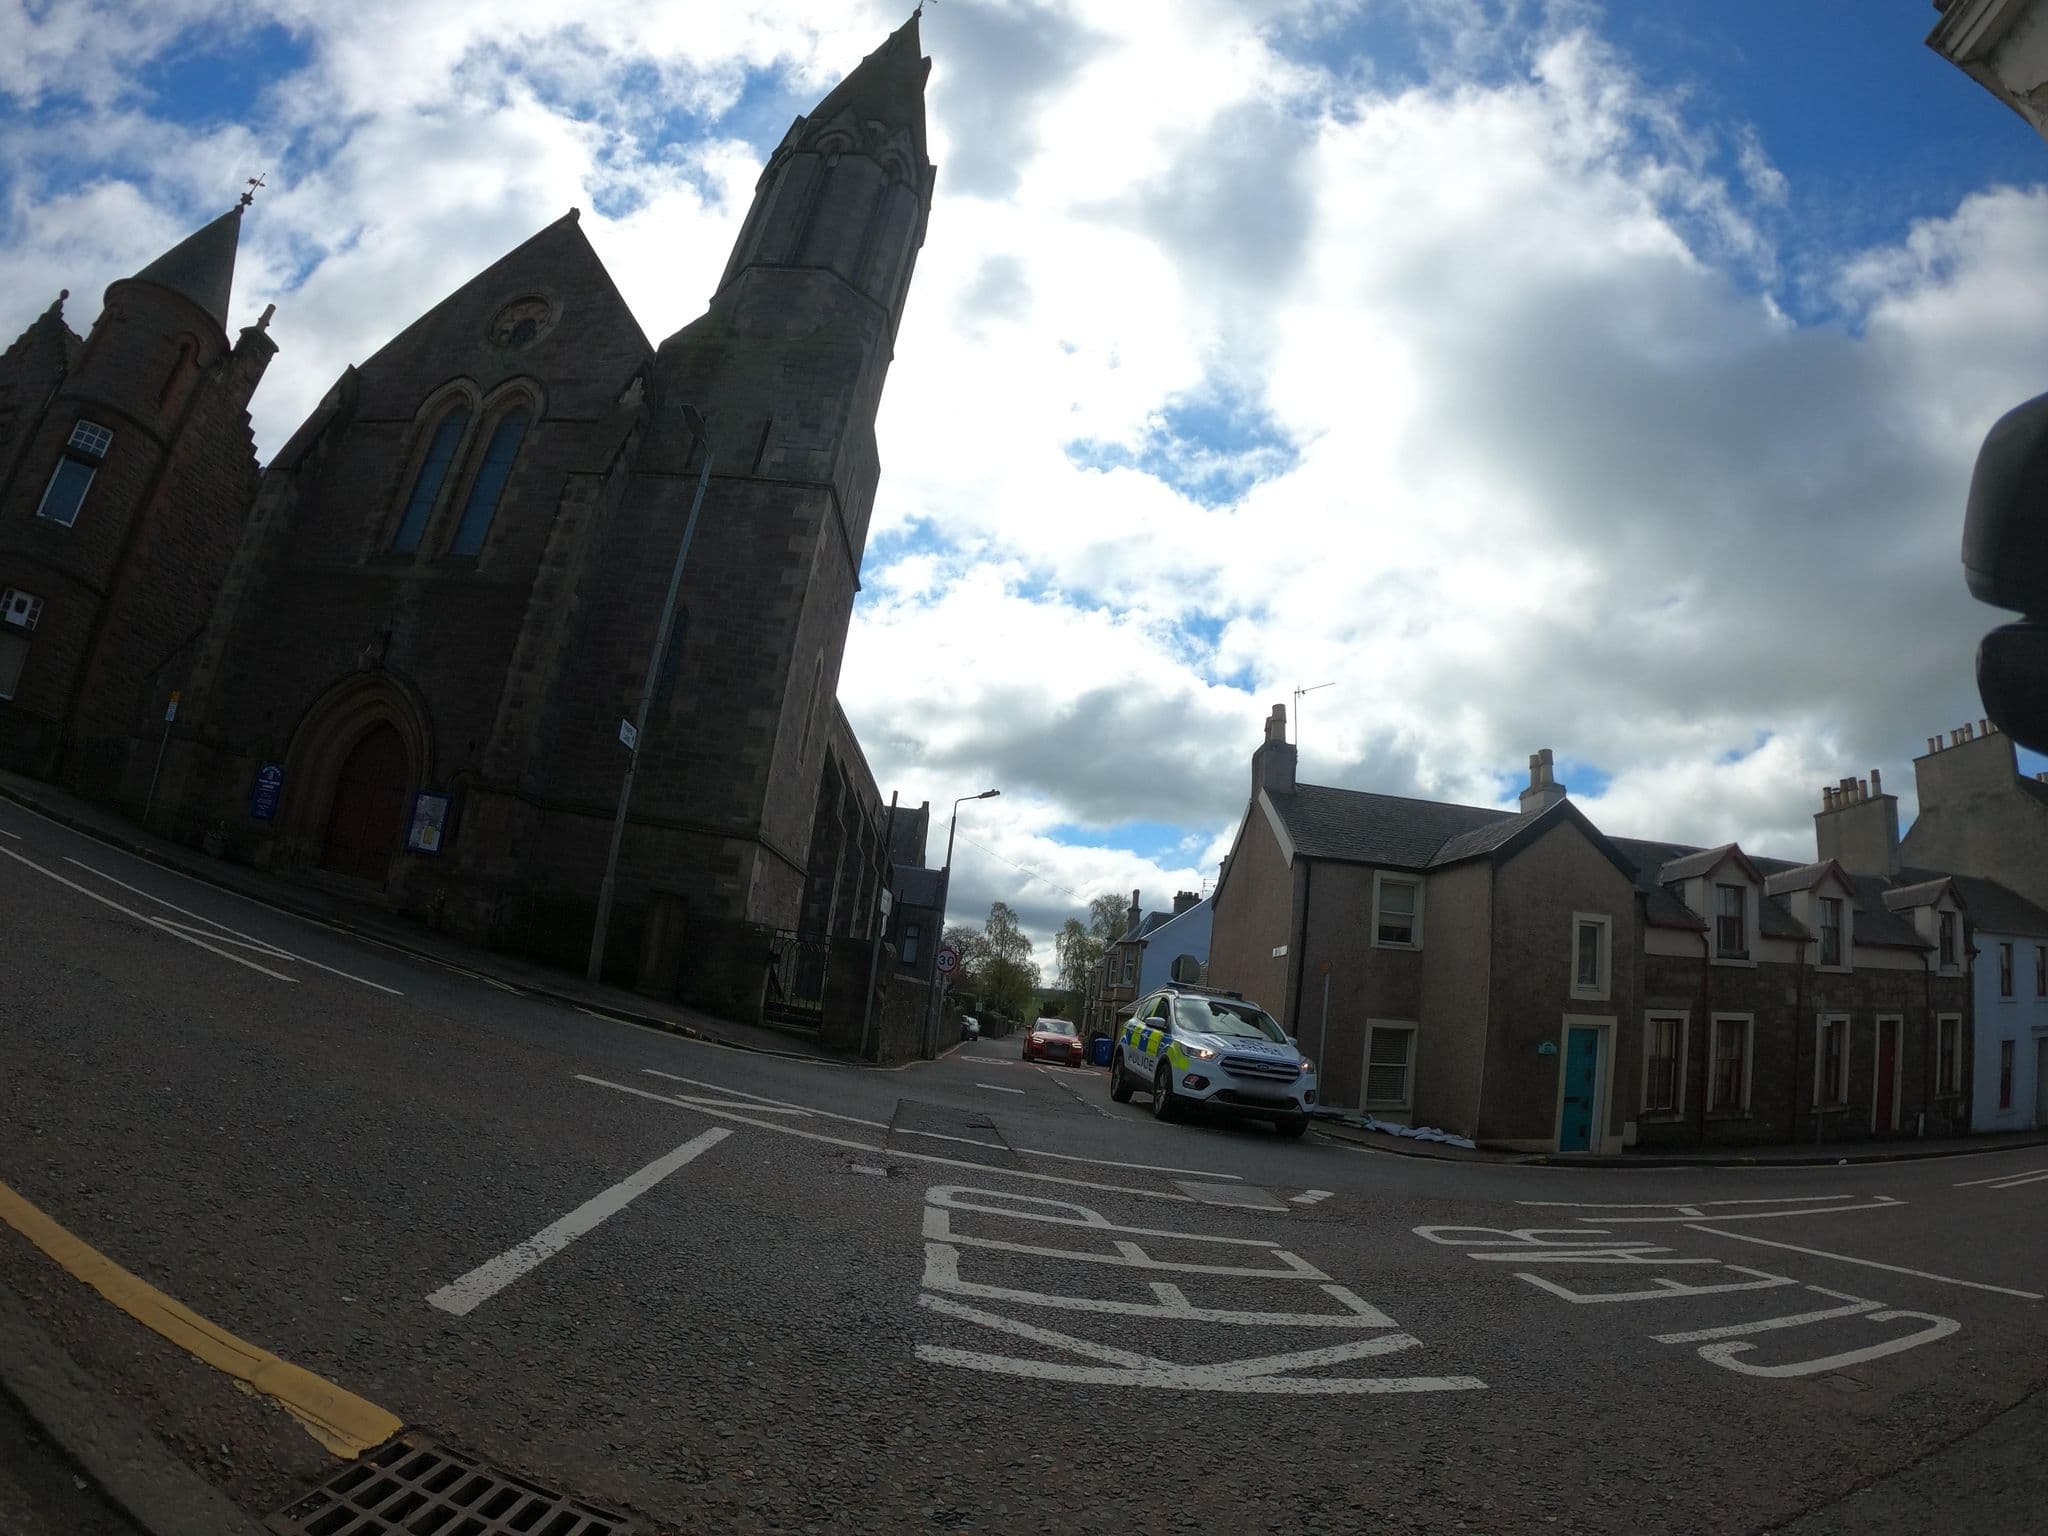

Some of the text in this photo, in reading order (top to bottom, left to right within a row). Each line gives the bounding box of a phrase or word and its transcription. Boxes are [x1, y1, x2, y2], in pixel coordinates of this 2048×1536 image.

[939, 955, 955, 967] 30
[914, 1185, 1489, 1394] KEEP
[1412, 1225, 1962, 1378] CLEAR
